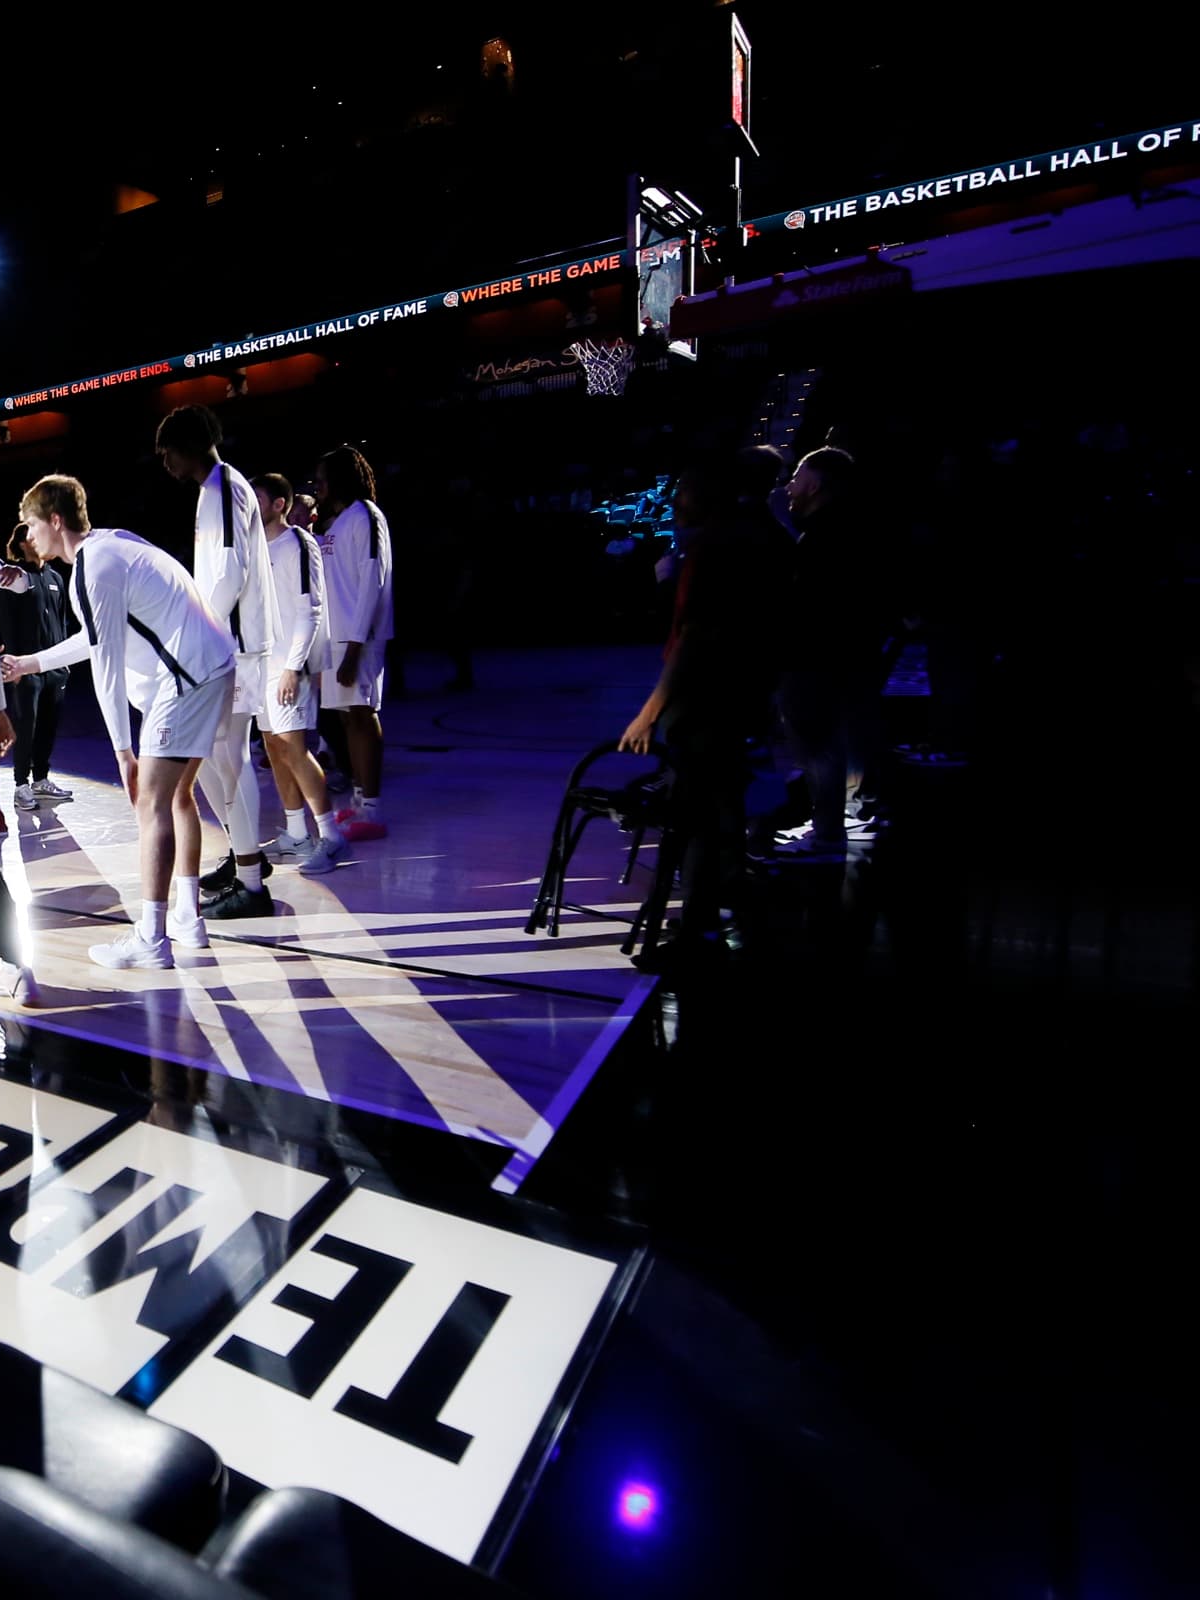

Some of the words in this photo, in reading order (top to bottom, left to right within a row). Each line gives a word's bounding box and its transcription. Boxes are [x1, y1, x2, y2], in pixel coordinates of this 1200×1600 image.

[809, 199, 858, 225] THE
[864, 159, 1041, 213] BASKETBALL
[1049, 140, 1128, 173] HALL
[1137, 127, 1182, 153] OF
[460, 279, 524, 305] WHERE
[526, 269, 563, 289] THE
[565, 255, 622, 280] GAME
[196, 349, 222, 365] THE
[224, 328, 313, 359] BASKETBALL
[315, 318, 354, 337] HALL
[357, 312, 380, 327] OF
[383, 300, 427, 322] FAME
[14, 390, 48, 408] WHERE
[49, 385, 69, 399] THE
[71, 379, 100, 394] GAME
[102, 371, 137, 388] NEVER
[140, 361, 173, 378] ENDS.
[473, 357, 557, 382] Mohegan
